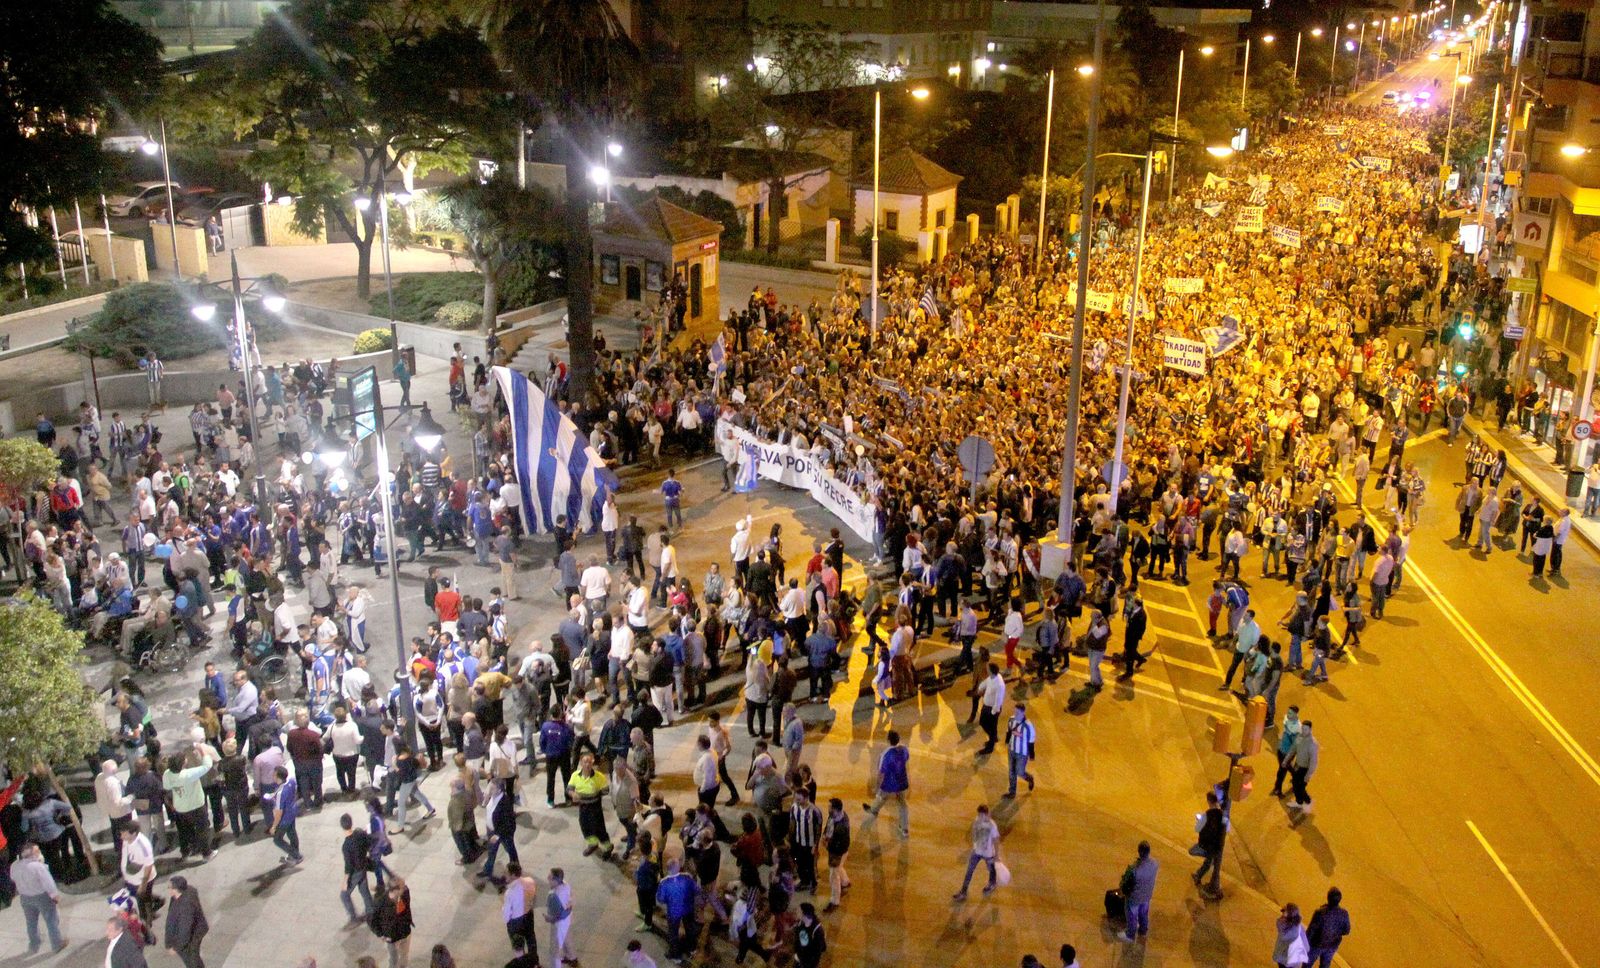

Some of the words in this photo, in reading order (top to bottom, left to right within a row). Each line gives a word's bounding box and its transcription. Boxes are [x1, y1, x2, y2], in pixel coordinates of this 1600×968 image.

[1165, 341, 1203, 354] TRADICION
[1164, 356, 1202, 368] IDENTIDAD
[824, 479, 854, 515] RECRE
